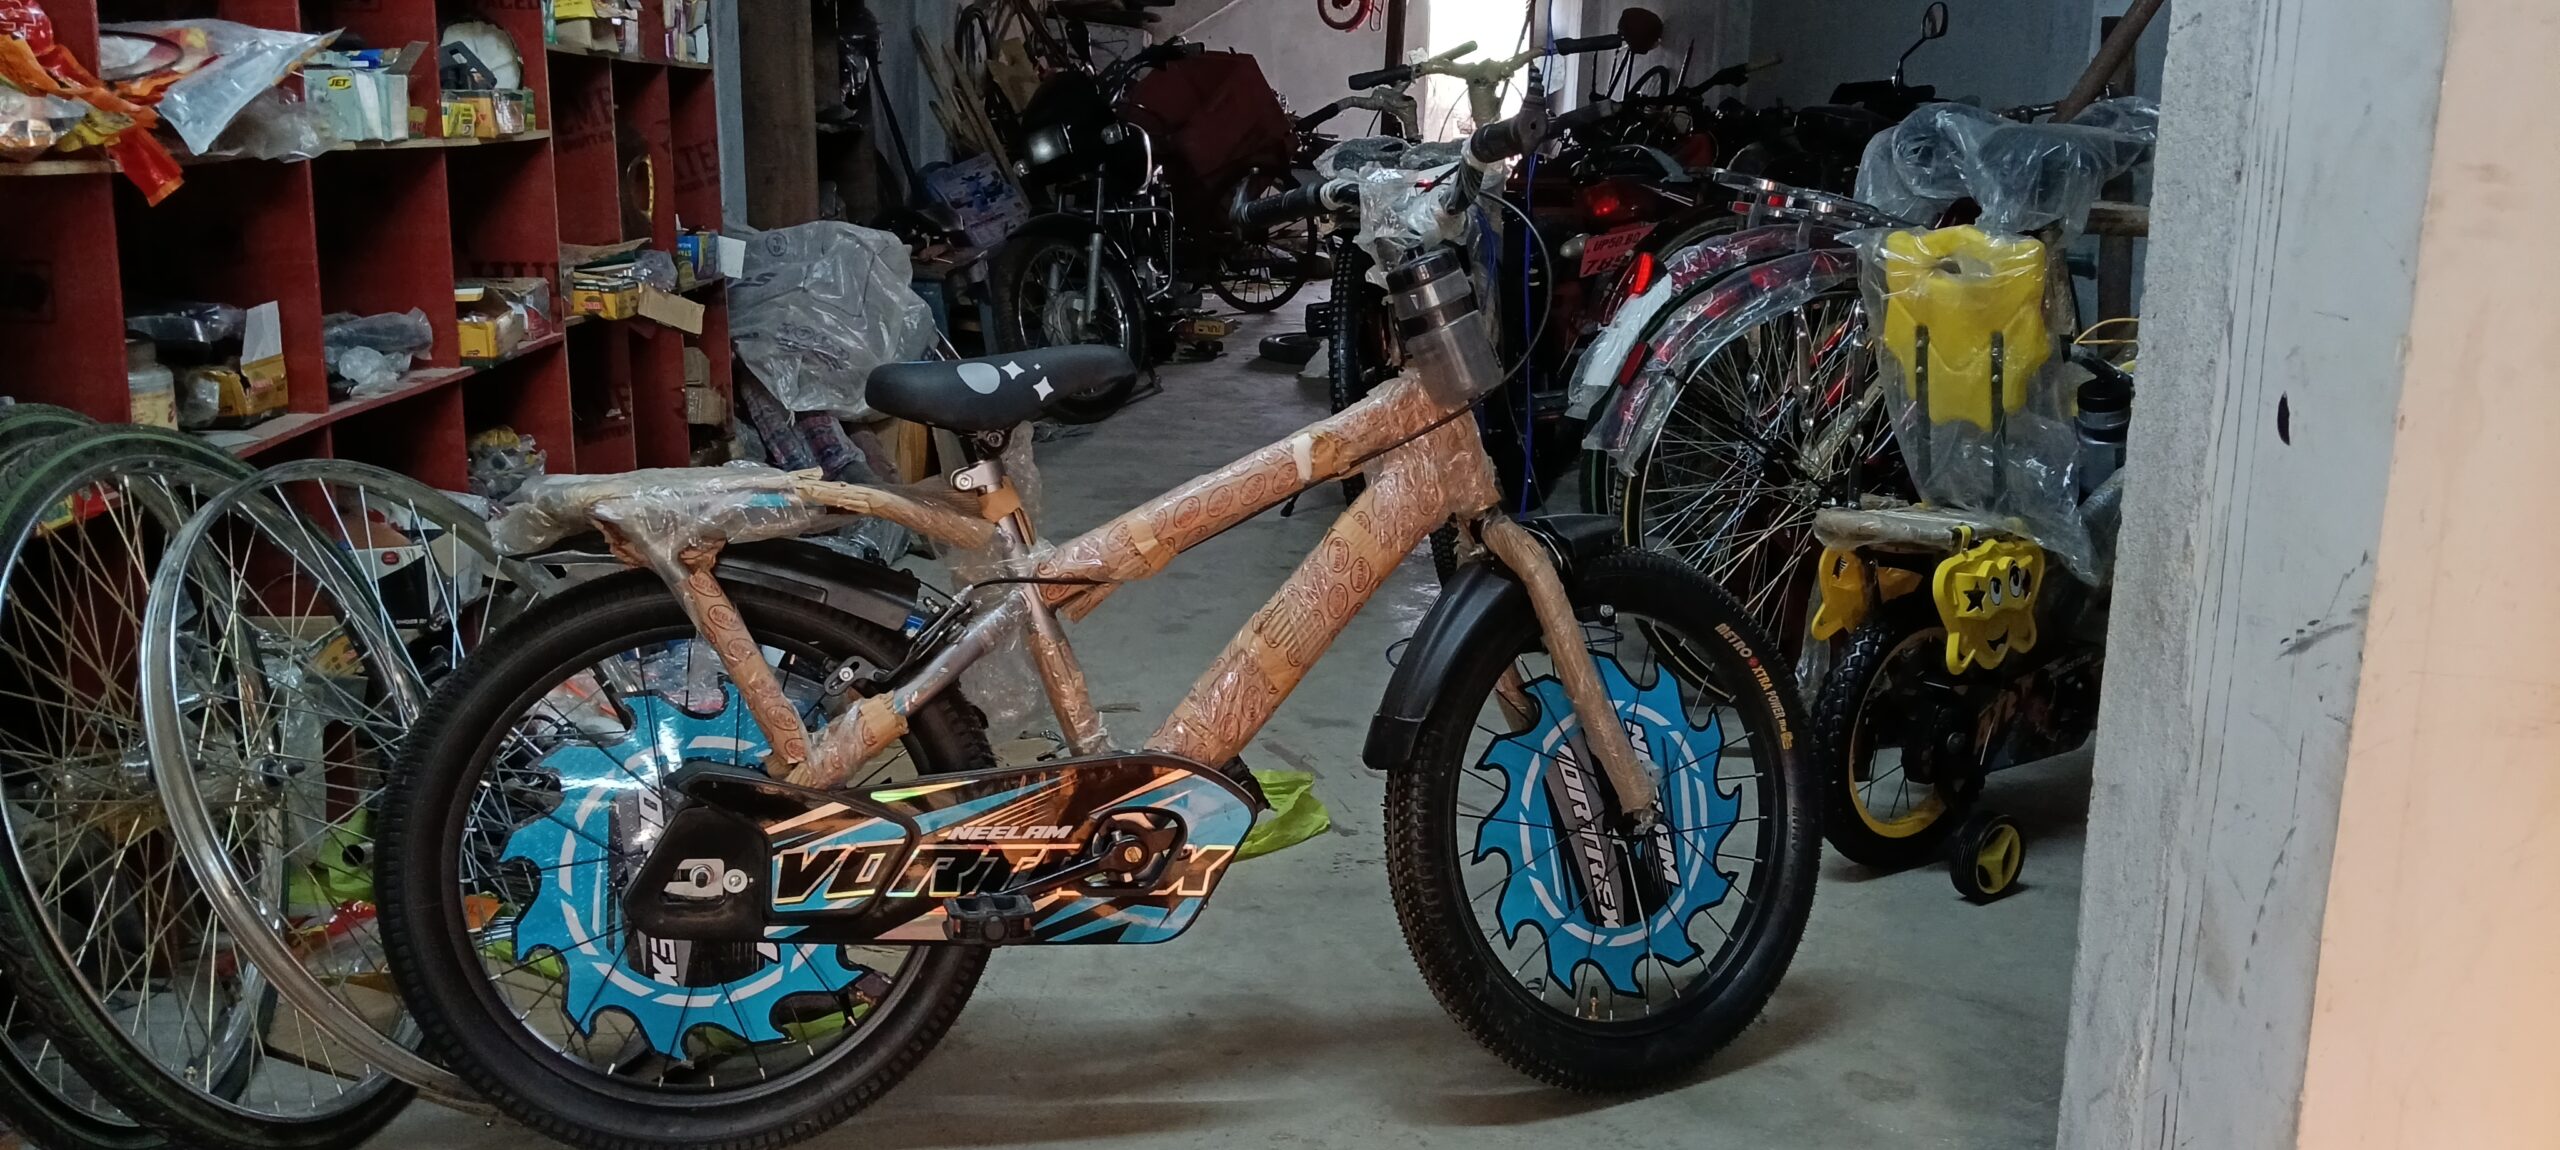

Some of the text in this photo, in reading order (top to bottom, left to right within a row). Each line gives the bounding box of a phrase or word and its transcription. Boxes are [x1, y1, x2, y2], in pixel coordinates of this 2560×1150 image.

[328, 77, 349, 88] JET
[1714, 622, 1753, 658] METRO
[1751, 664, 1773, 692] XTRA
[1765, 690, 1786, 720] POWER
[947, 825, 1074, 841] NEELAM
